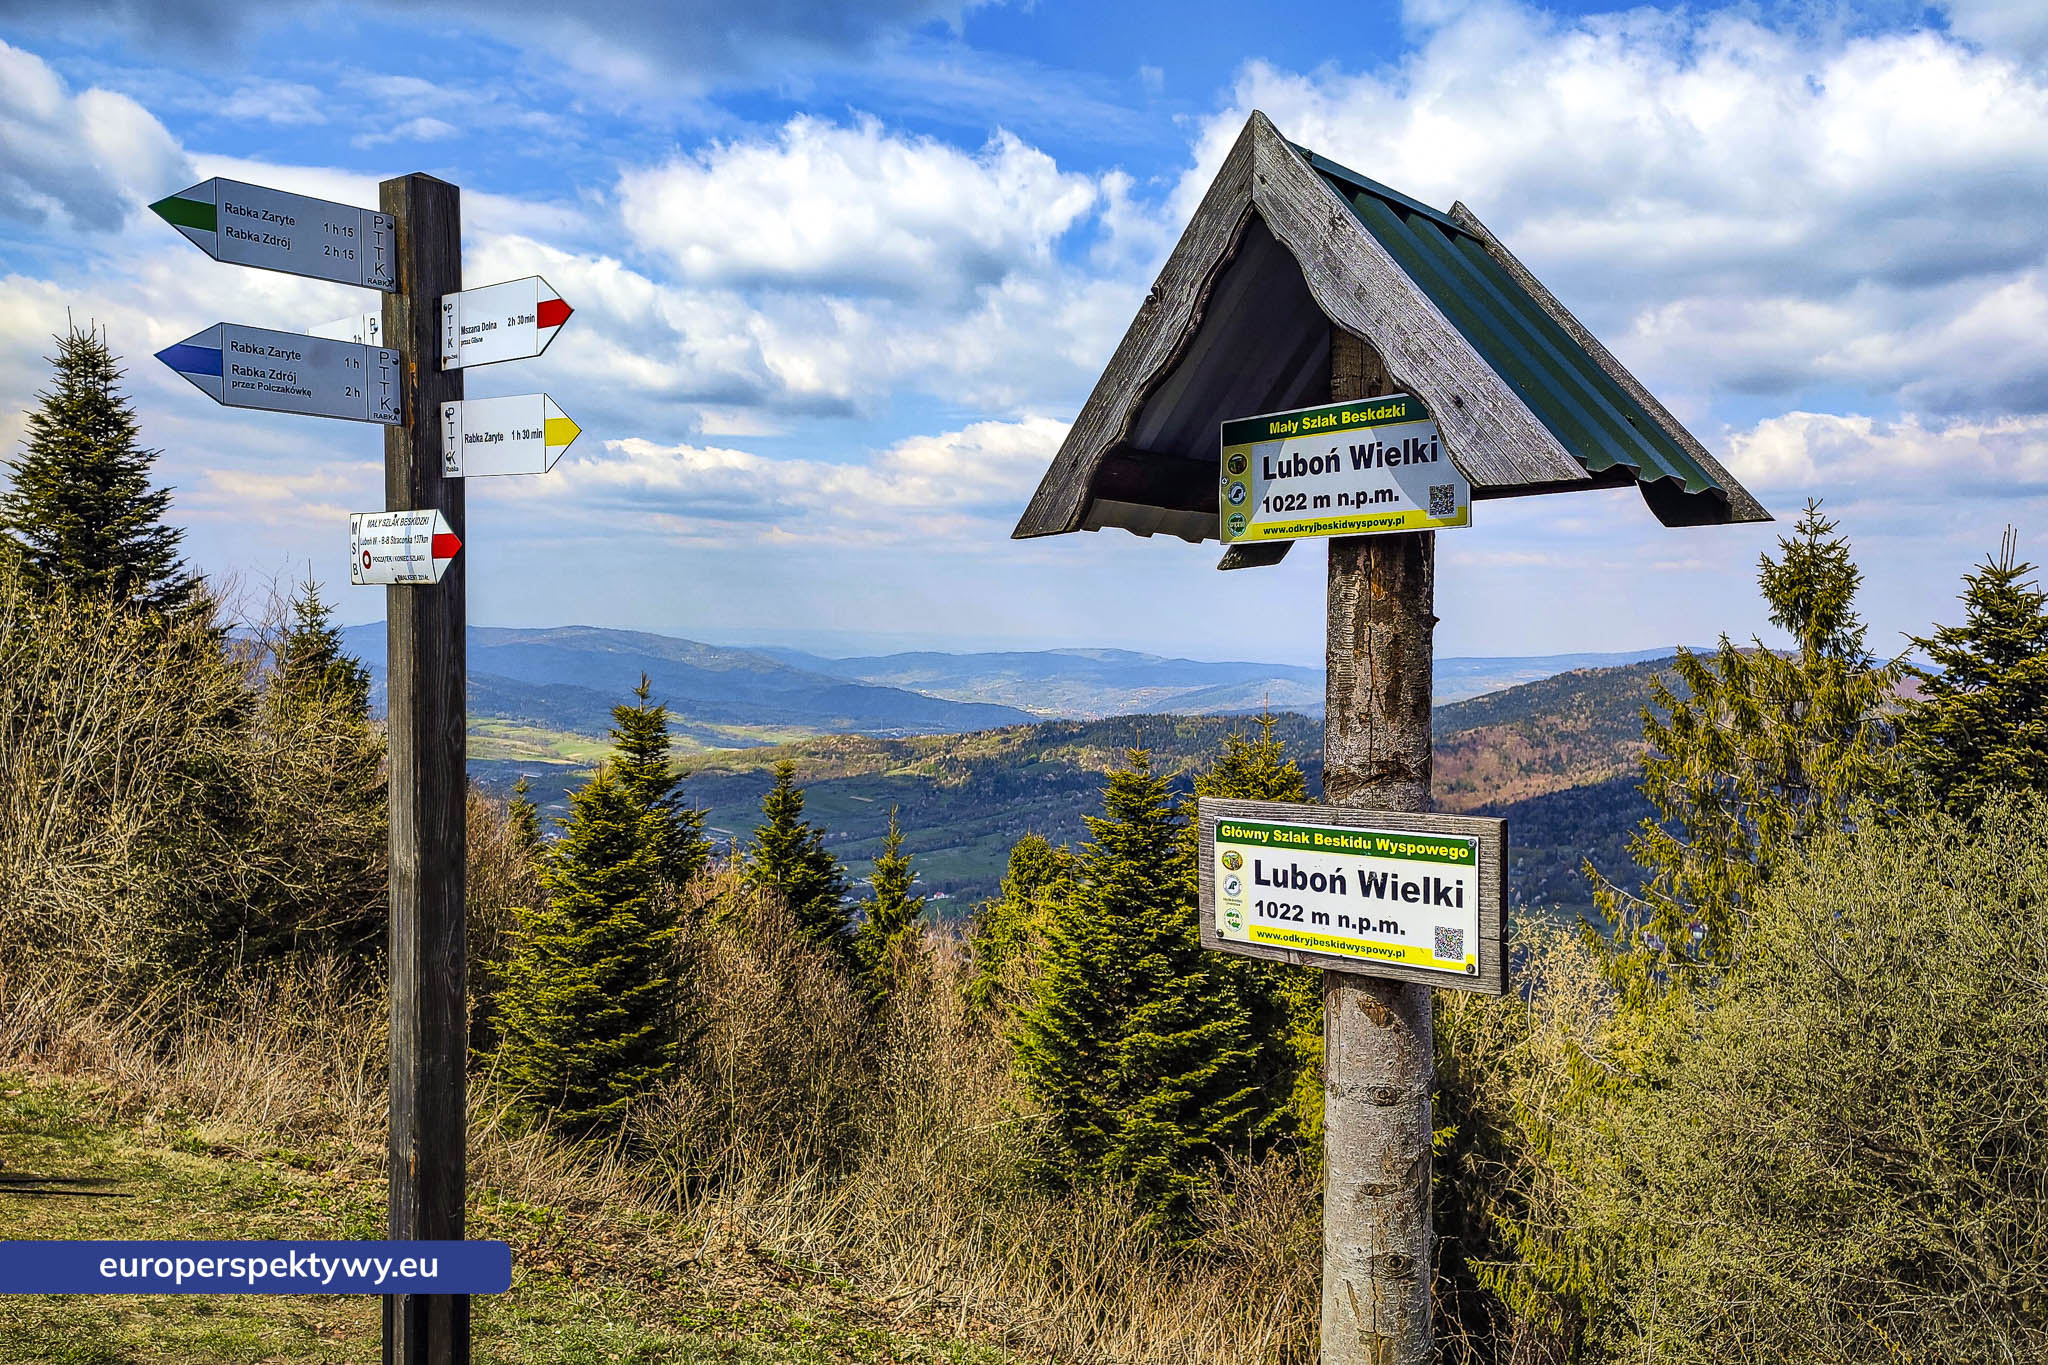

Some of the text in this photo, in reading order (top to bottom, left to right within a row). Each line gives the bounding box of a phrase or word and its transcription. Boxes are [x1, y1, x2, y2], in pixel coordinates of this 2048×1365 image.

[224, 202, 296, 226] Rabka Zaryte
[225, 226, 291, 250] Rabka Zdrój
[323, 222, 354, 238] 1 h 15
[324, 245, 354, 260] 2 h 15
[373, 215, 386, 278] PTTK
[367, 277, 394, 288] RABKA
[230, 340, 302, 361] Rabka Zaryte
[345, 357, 360, 369] 1 h
[231, 364, 297, 385] Rabka Zdrój
[379, 351, 391, 411] PTTK
[231, 380, 312, 398] przez Polczakówkę
[345, 386, 360, 398] 2 h
[373, 412, 399, 422] RABKA
[1269, 403, 1406, 436] Mały Szlak Beskdzki
[464, 431, 504, 445] Rabka Zaryte
[522, 429, 530, 440] 30
[530, 427, 543, 439] min
[1262, 434, 1438, 480] Luboń Wielki
[1262, 487, 1400, 513] 1022 m n.p.m.
[1221, 824, 1469, 860] Główny Szlak Beskidu Wyspowego
[1254, 859, 1464, 909] Luboń Wielki
[1254, 900, 1406, 936] 1022 m n.p.m.
[1256, 929, 1406, 958] www.odkryjbeskidwyspowy.pl
